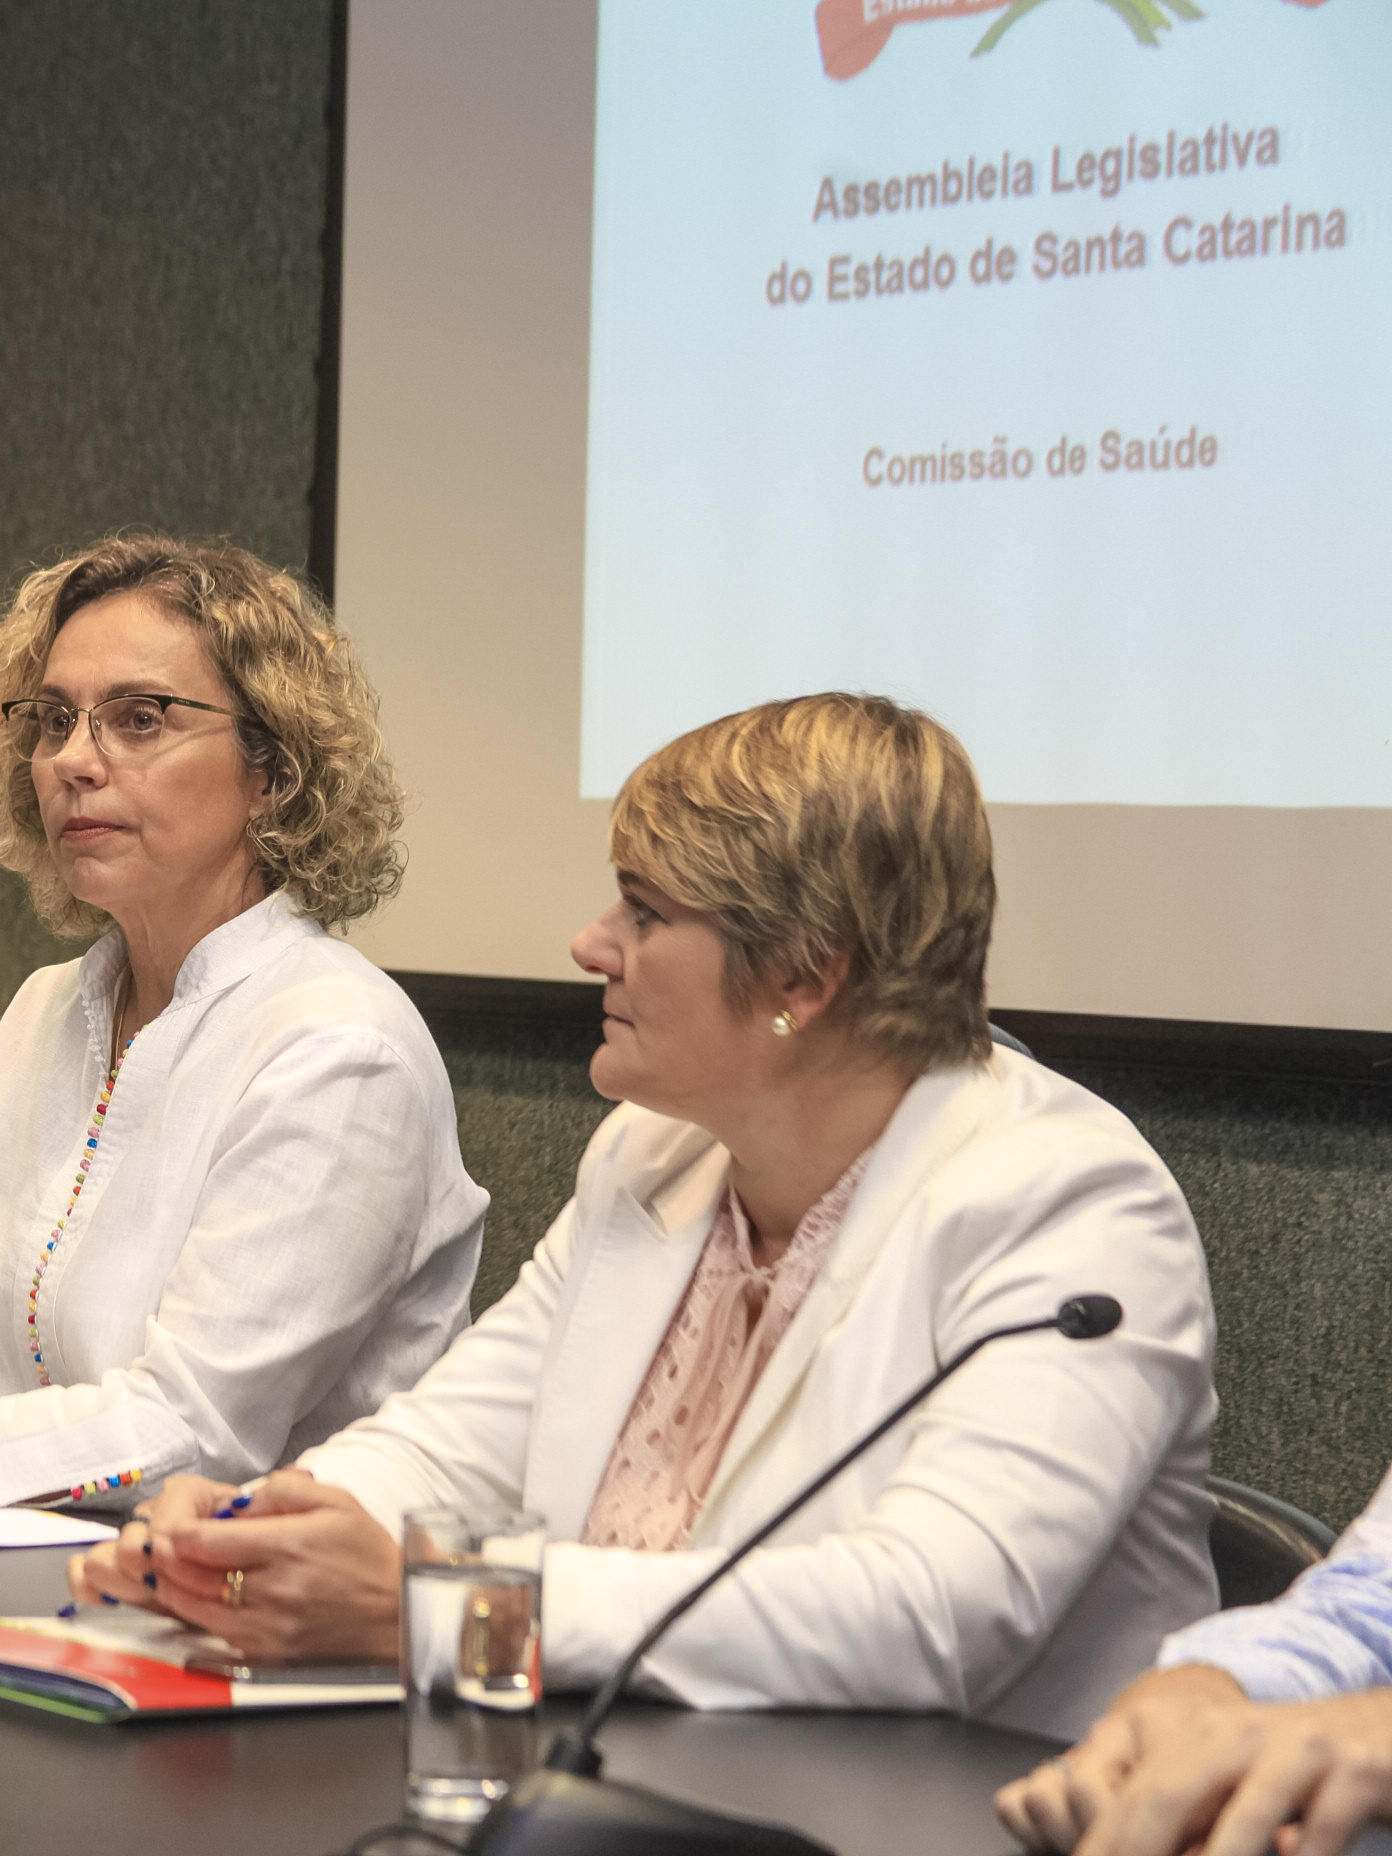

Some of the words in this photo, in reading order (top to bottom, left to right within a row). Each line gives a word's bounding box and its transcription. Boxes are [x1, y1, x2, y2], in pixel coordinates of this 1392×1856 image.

[812, 150, 1034, 223] Assembleia
[1051, 122, 1281, 202] Legislativa
[766, 260, 811, 306] do
[827, 244, 956, 302] Estado
[969, 237, 1017, 286] de
[1033, 223, 1147, 281] Santa
[1164, 203, 1347, 266] Catarina
[862, 436, 1033, 488] Comissão
[1046, 436, 1087, 478] de
[1099, 425, 1218, 474] Saúde
